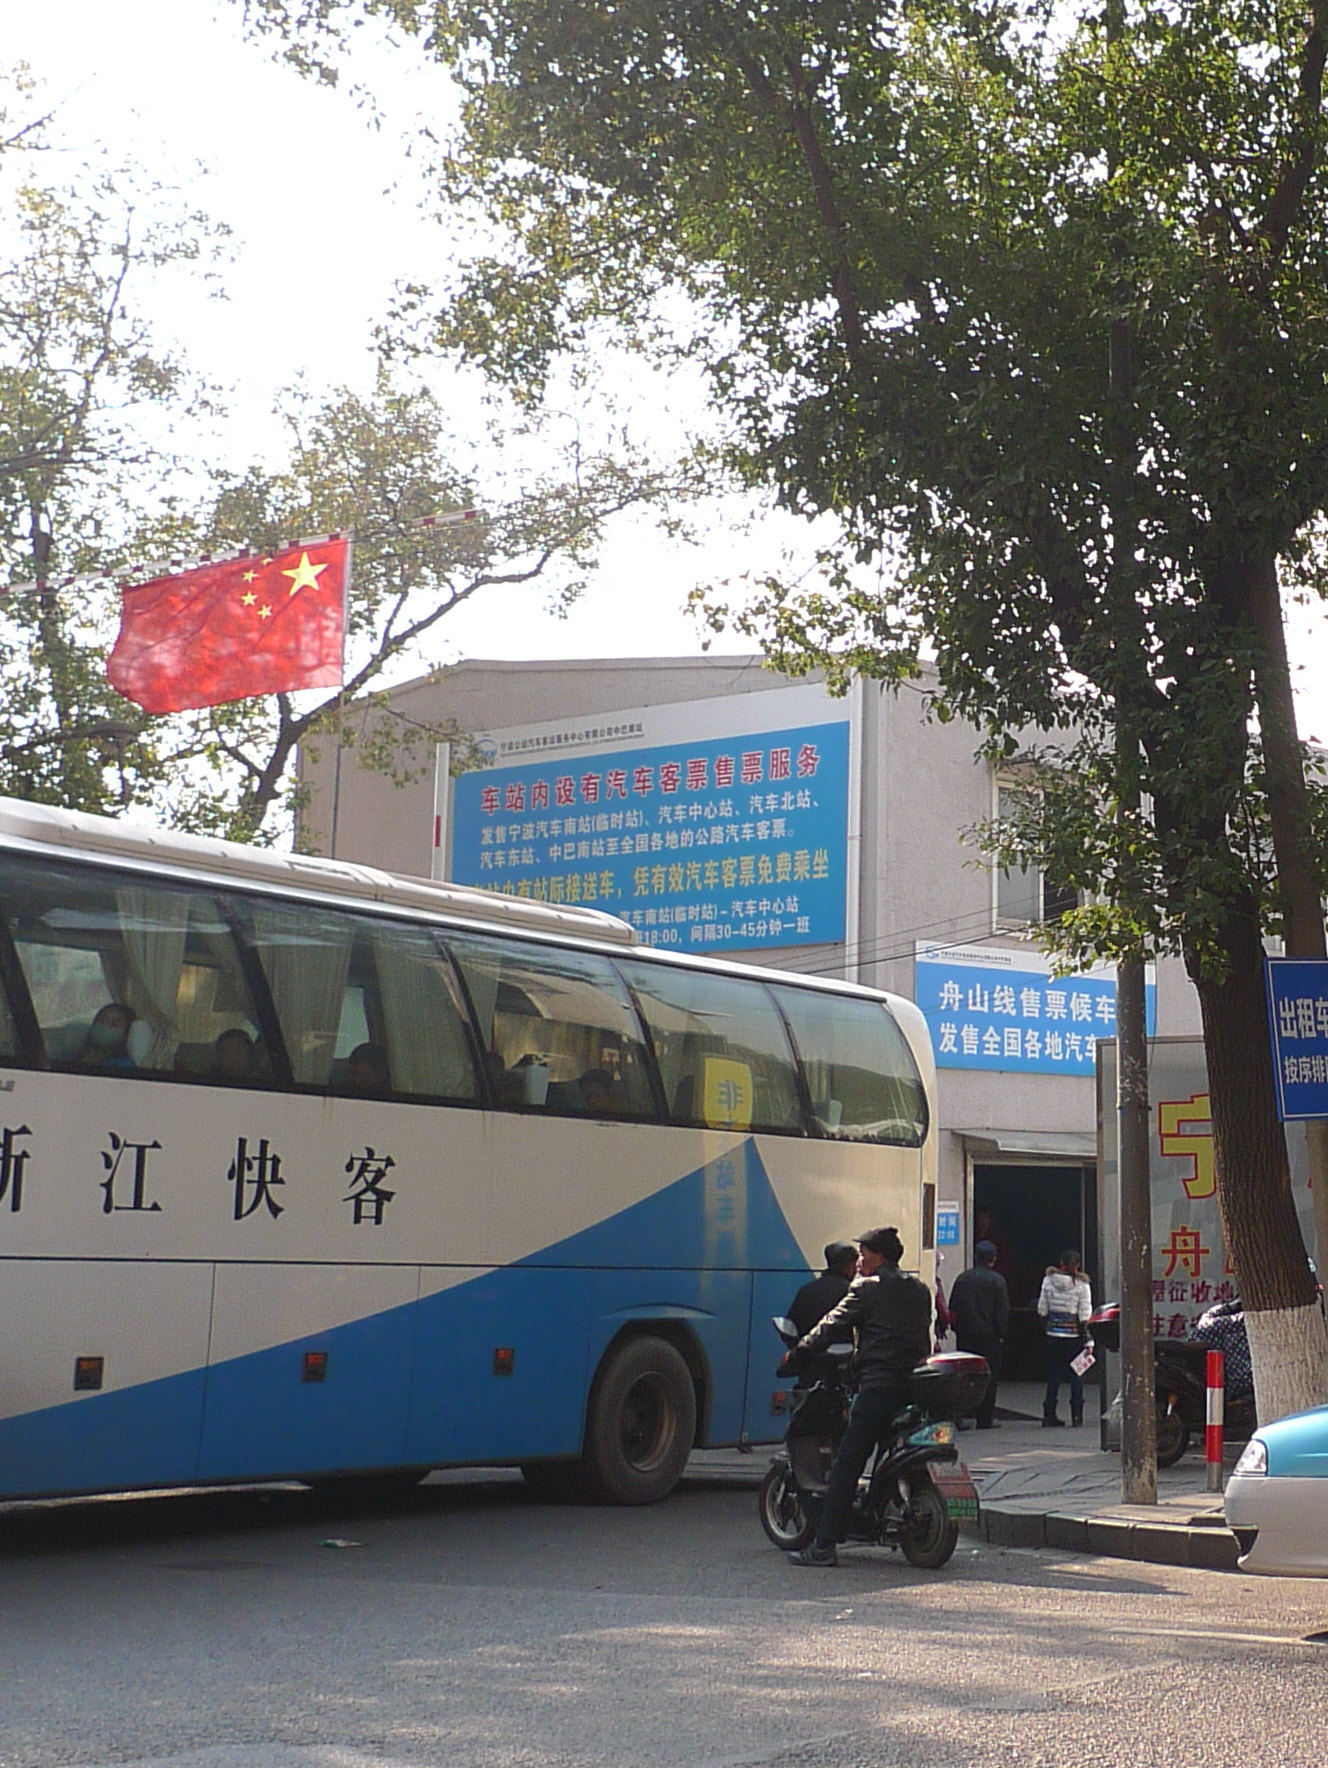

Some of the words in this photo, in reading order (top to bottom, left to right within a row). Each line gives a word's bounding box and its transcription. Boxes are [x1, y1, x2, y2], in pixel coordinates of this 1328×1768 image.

[480, 743, 821, 816] 车站内设有汽车客票售票服务
[938, 980, 1117, 1024] 舟山线售票候车
